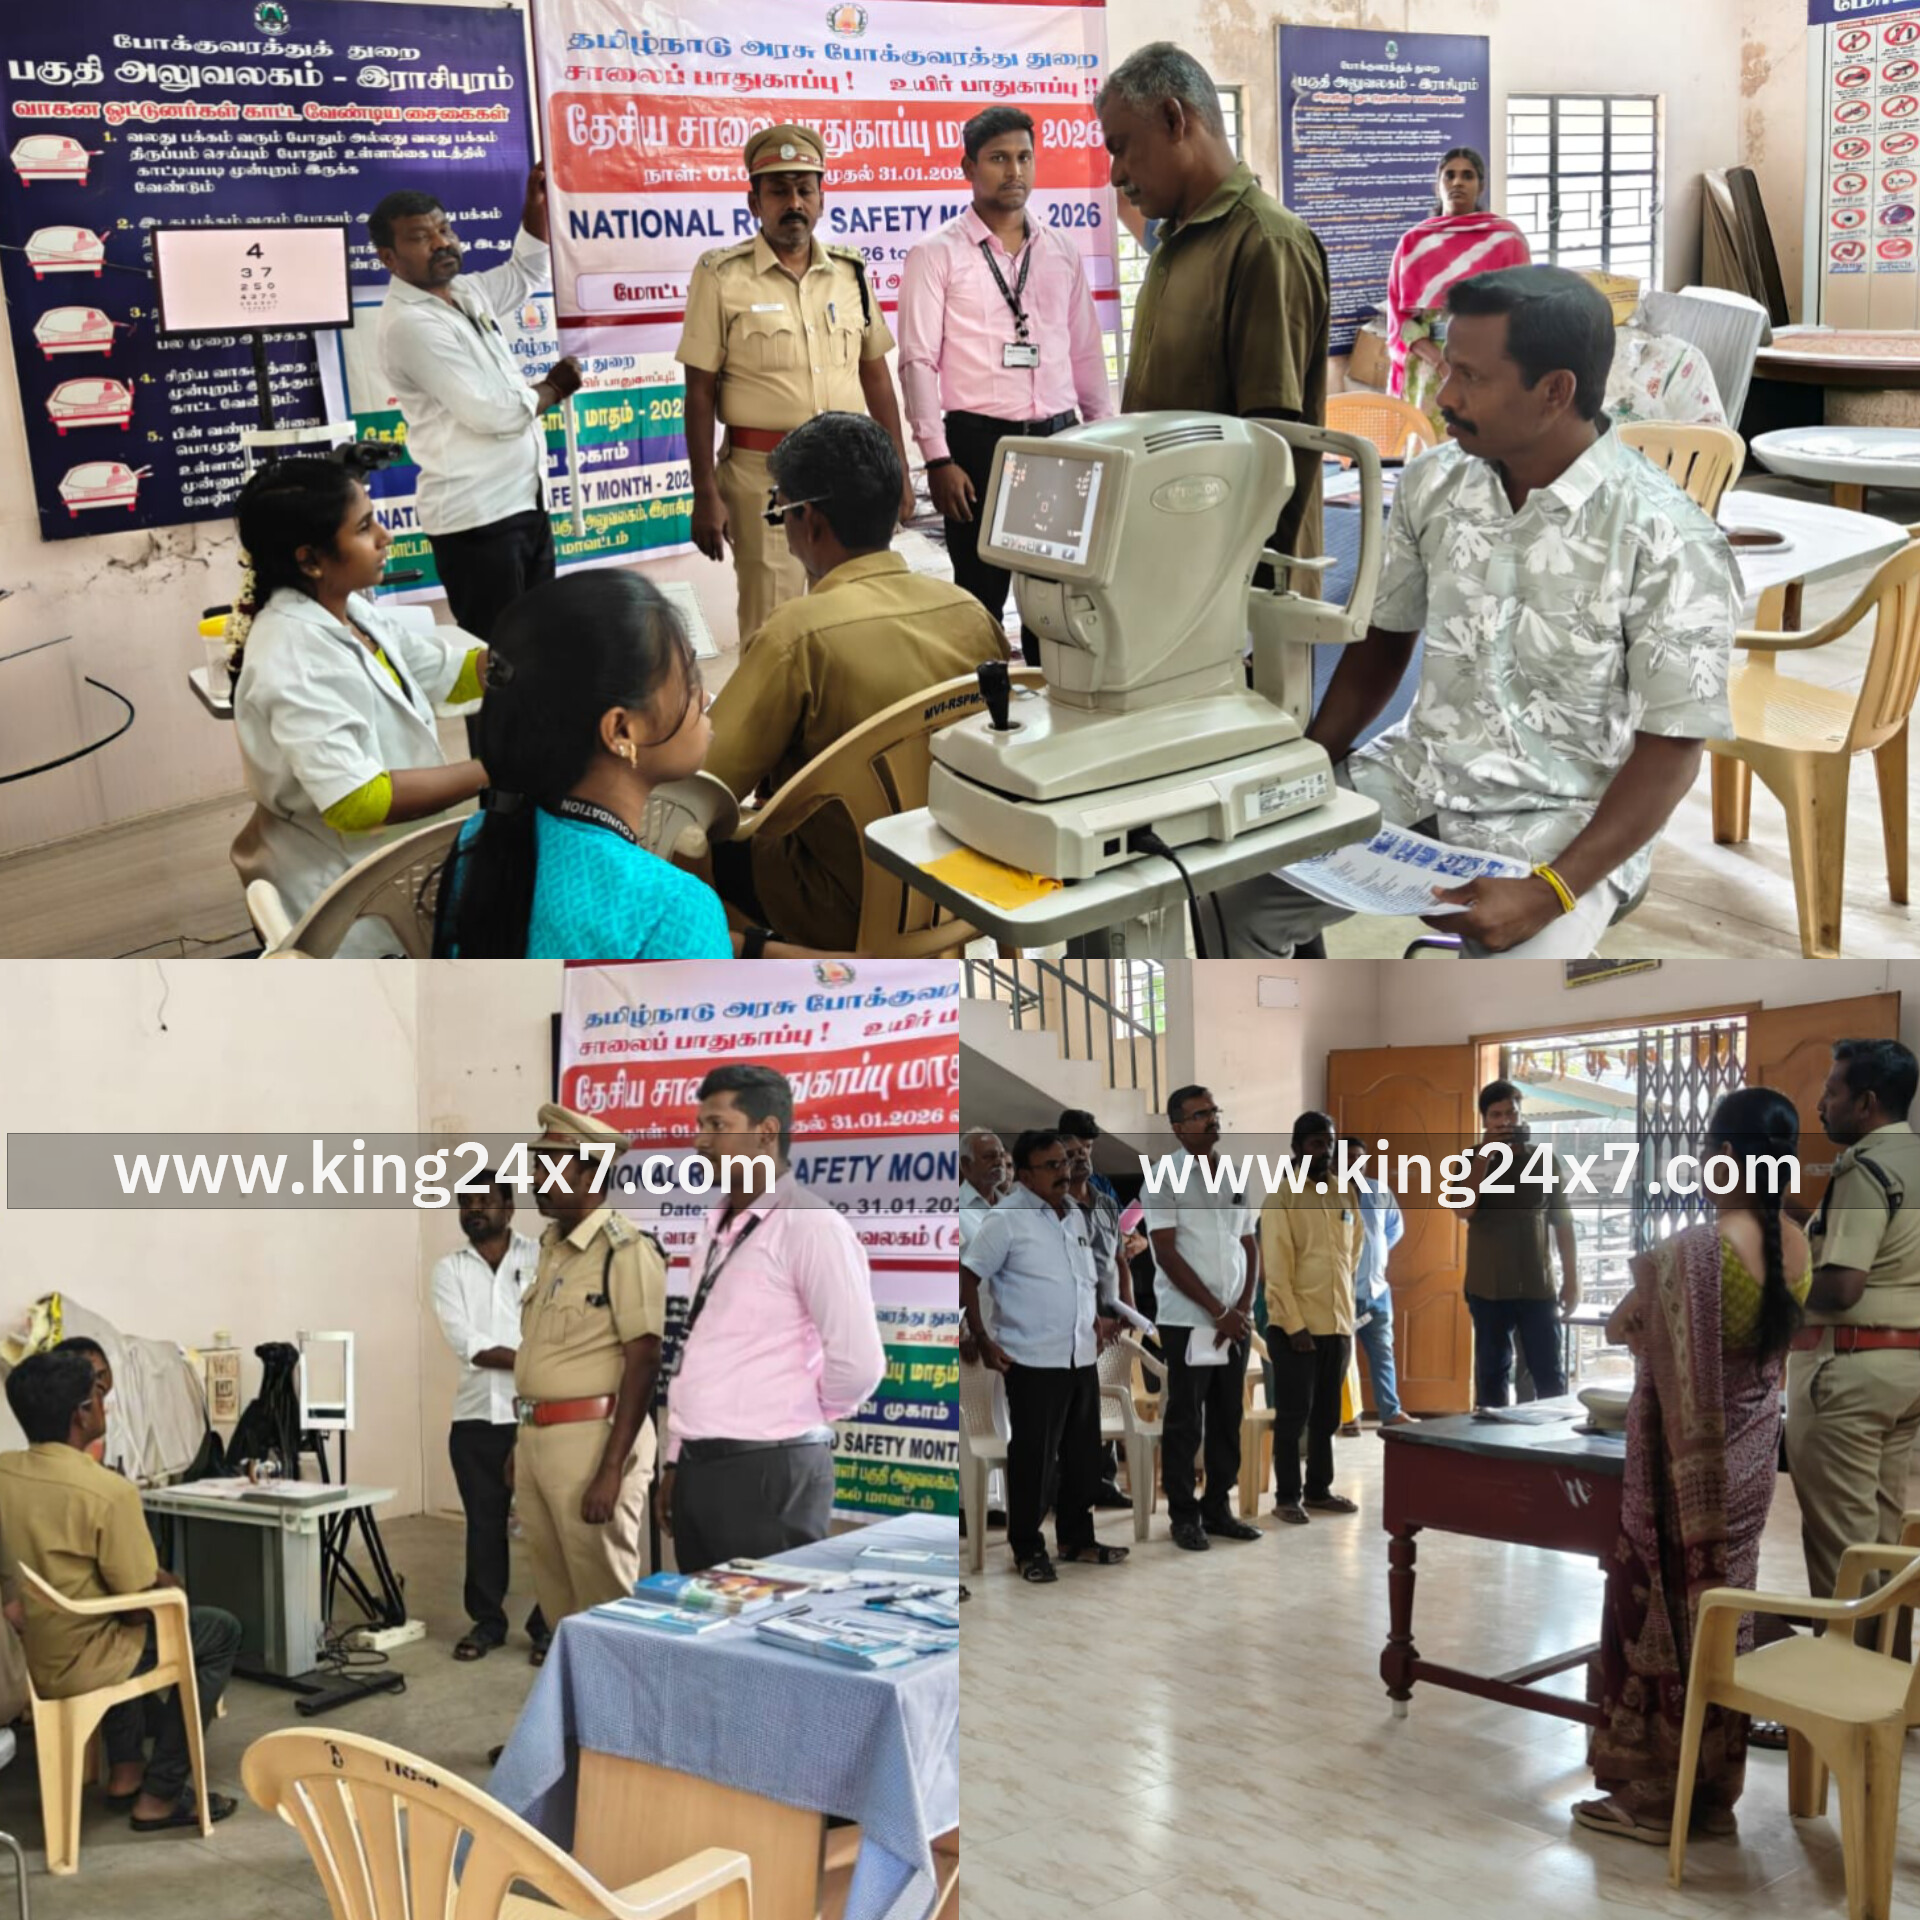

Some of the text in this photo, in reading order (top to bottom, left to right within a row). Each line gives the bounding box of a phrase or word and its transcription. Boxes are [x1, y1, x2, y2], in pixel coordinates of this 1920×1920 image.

[113, 34, 421, 61] போக்குவரத்துத் துறை
[566, 29, 1099, 69] தமிழ்நாடு அரசு போக்குவரத்து துறை
[8, 54, 104, 87] பகுதி
[114, 60, 324, 92] அலுவலகம்
[356, 64, 515, 95] இராசிபுரம்
[564, 62, 686, 85] சாலைப்
[693, 68, 839, 93] பாதுகாப்பு
[889, 74, 953, 93] உயிர்
[961, 77, 1079, 97] பாதுகாப்பு
[12, 101, 102, 118] வாகன
[243, 103, 302, 121] காட்ட
[302, 101, 403, 125] வேண்டிய
[565, 100, 668, 156] தேசிய
[1042, 118, 1104, 149] 2026
[878, 166, 966, 181] 31.01.202
[569, 208, 724, 239] NATIONAL
[830, 204, 932, 234] SAFETY
[1048, 202, 1102, 229] 2026
[246, 242, 264, 259] 4
[241, 266, 272, 278] 3 7
[650, 398, 682, 421] 202
[597, 475, 652, 501] MONTH
[666, 469, 690, 491] 202
[584, 1003, 715, 1030] தமிழ்நாடு
[723, 1001, 797, 1020] அரசு
[579, 1031, 668, 1056] சாலைப்
[675, 1024, 813, 1051] பாதுகாப்பு
[862, 1009, 934, 1037] உயிர்
[575, 1068, 646, 1117] தேசிய
[831, 1108, 944, 1129] 31.01.2026
[794, 1154, 884, 1185] AFETY
[888, 1150, 959, 1182] MON
[660, 1202, 709, 1217] Date:
[883, 1400, 949, 1422] முகாம்
[844, 1432, 905, 1459] SAFETY
